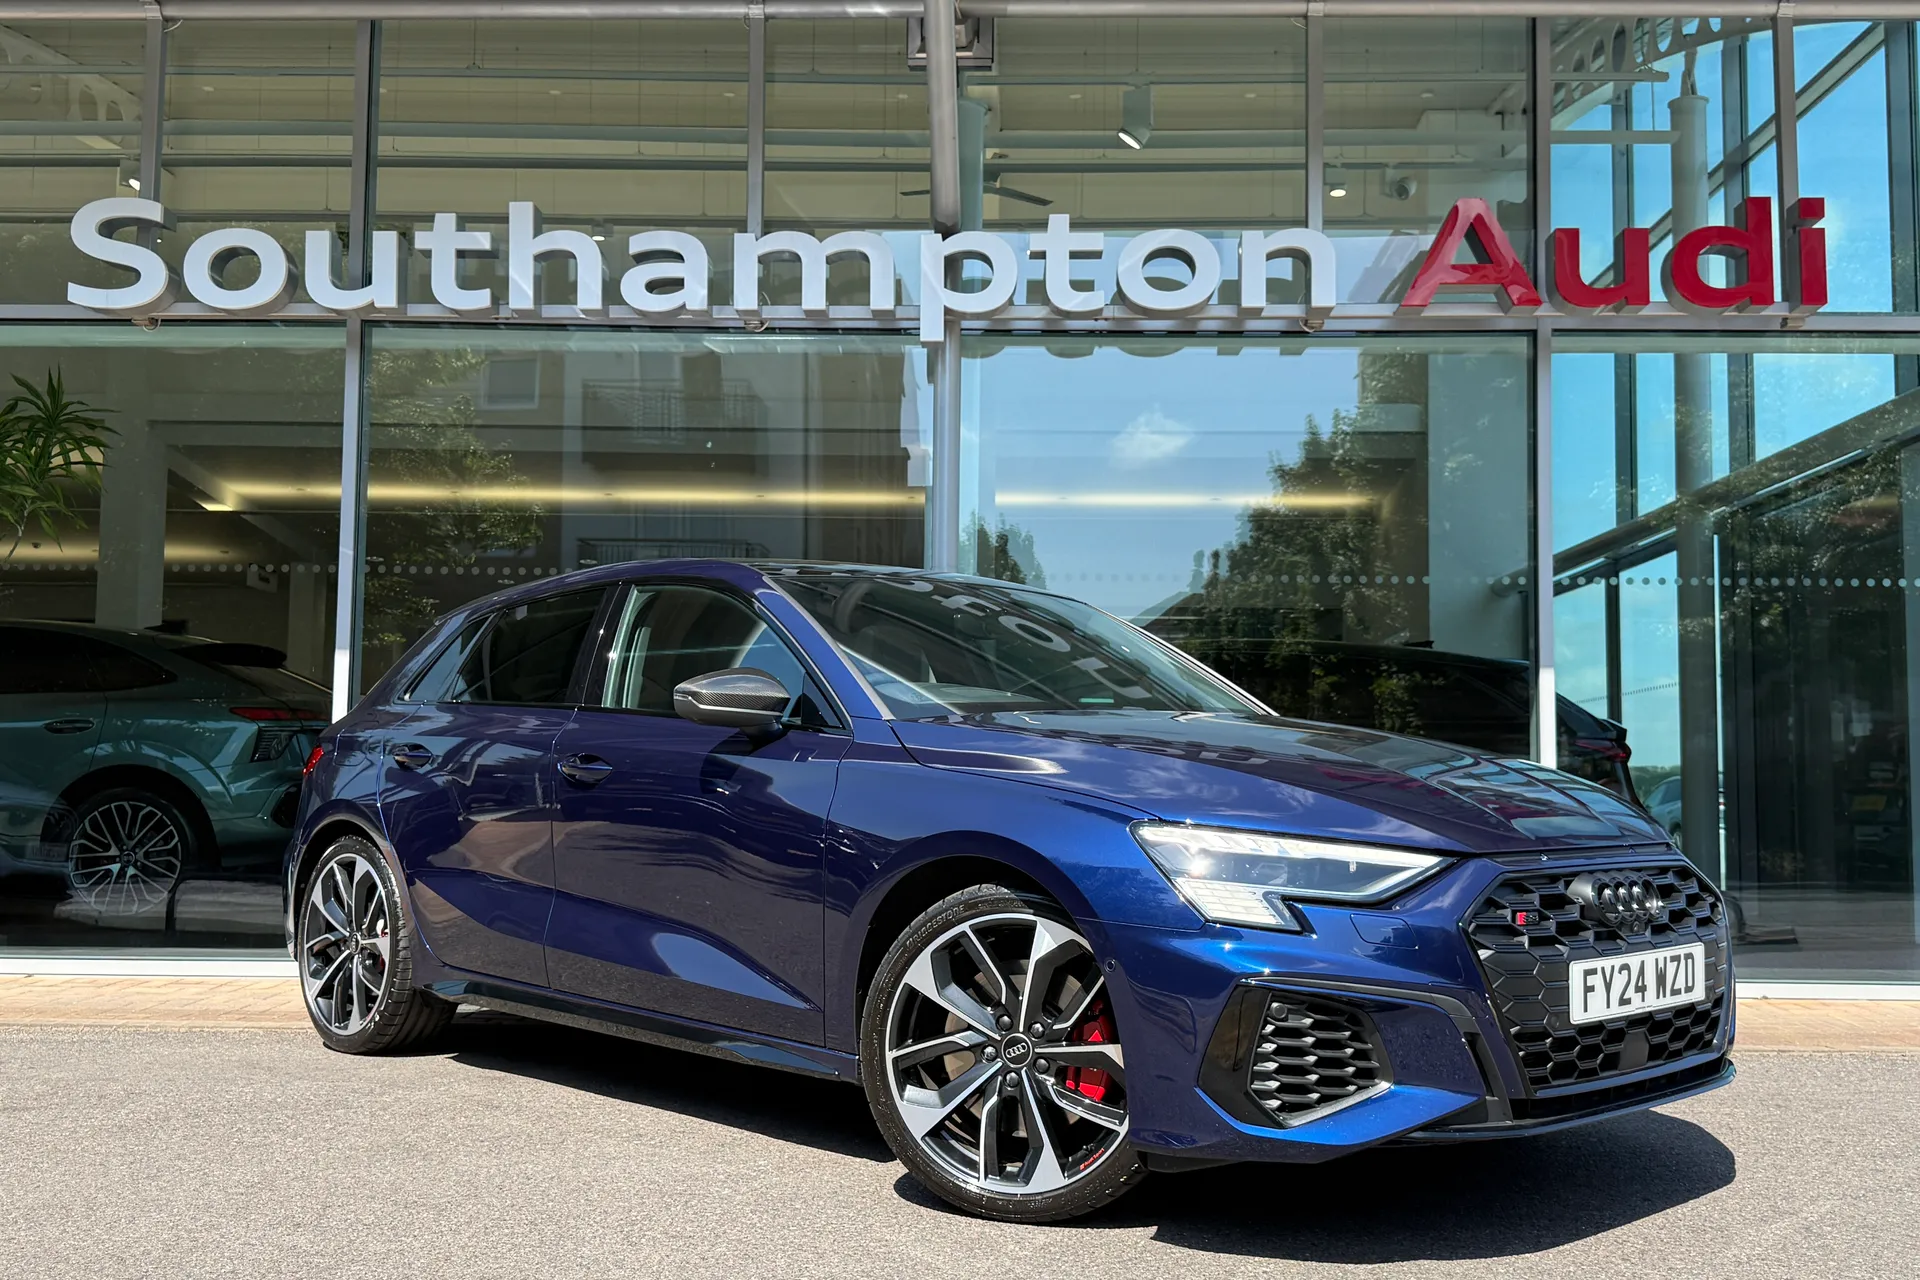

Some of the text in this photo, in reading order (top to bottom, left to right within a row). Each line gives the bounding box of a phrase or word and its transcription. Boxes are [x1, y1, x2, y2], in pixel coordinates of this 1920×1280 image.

[67, 196, 1828, 342] Southampton Audi
[1582, 952, 1695, 1013] FY24 WZD
